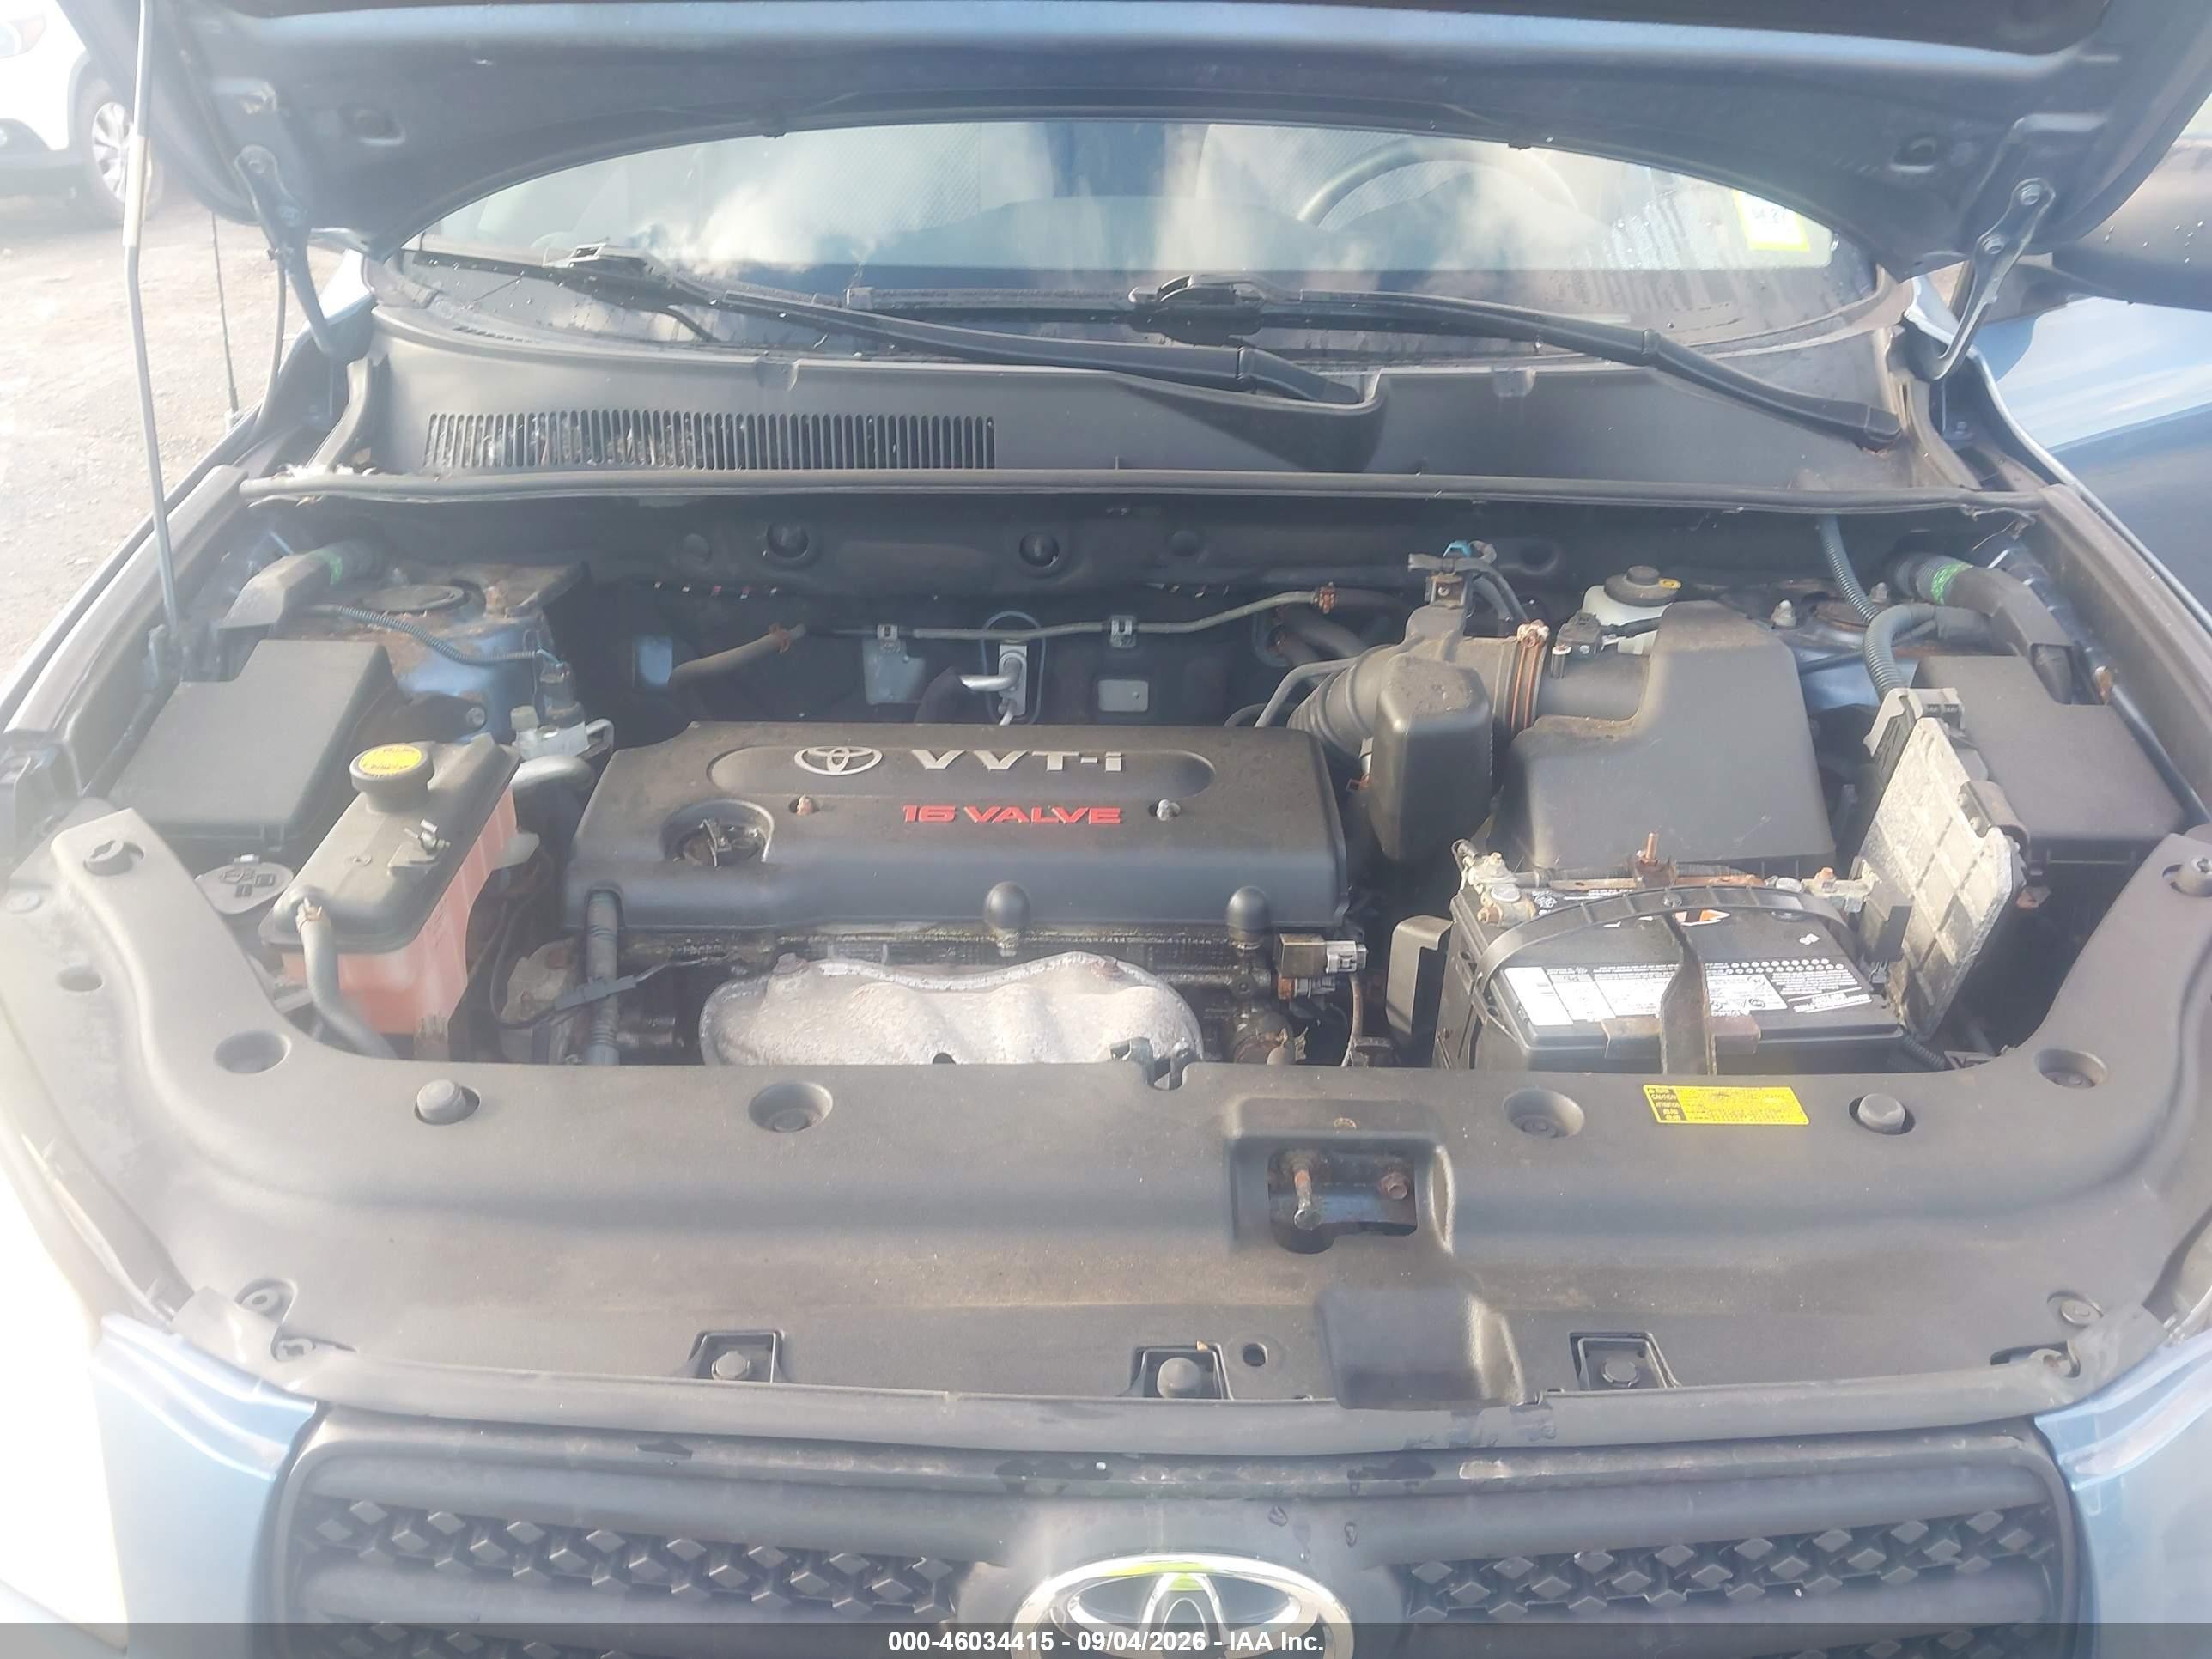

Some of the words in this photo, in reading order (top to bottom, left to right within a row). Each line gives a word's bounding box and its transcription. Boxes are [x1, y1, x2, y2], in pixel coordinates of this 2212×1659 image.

[911, 749, 1122, 772] VVT-i
[902, 805, 957, 823] 16
[963, 805, 1121, 824] VALVE
